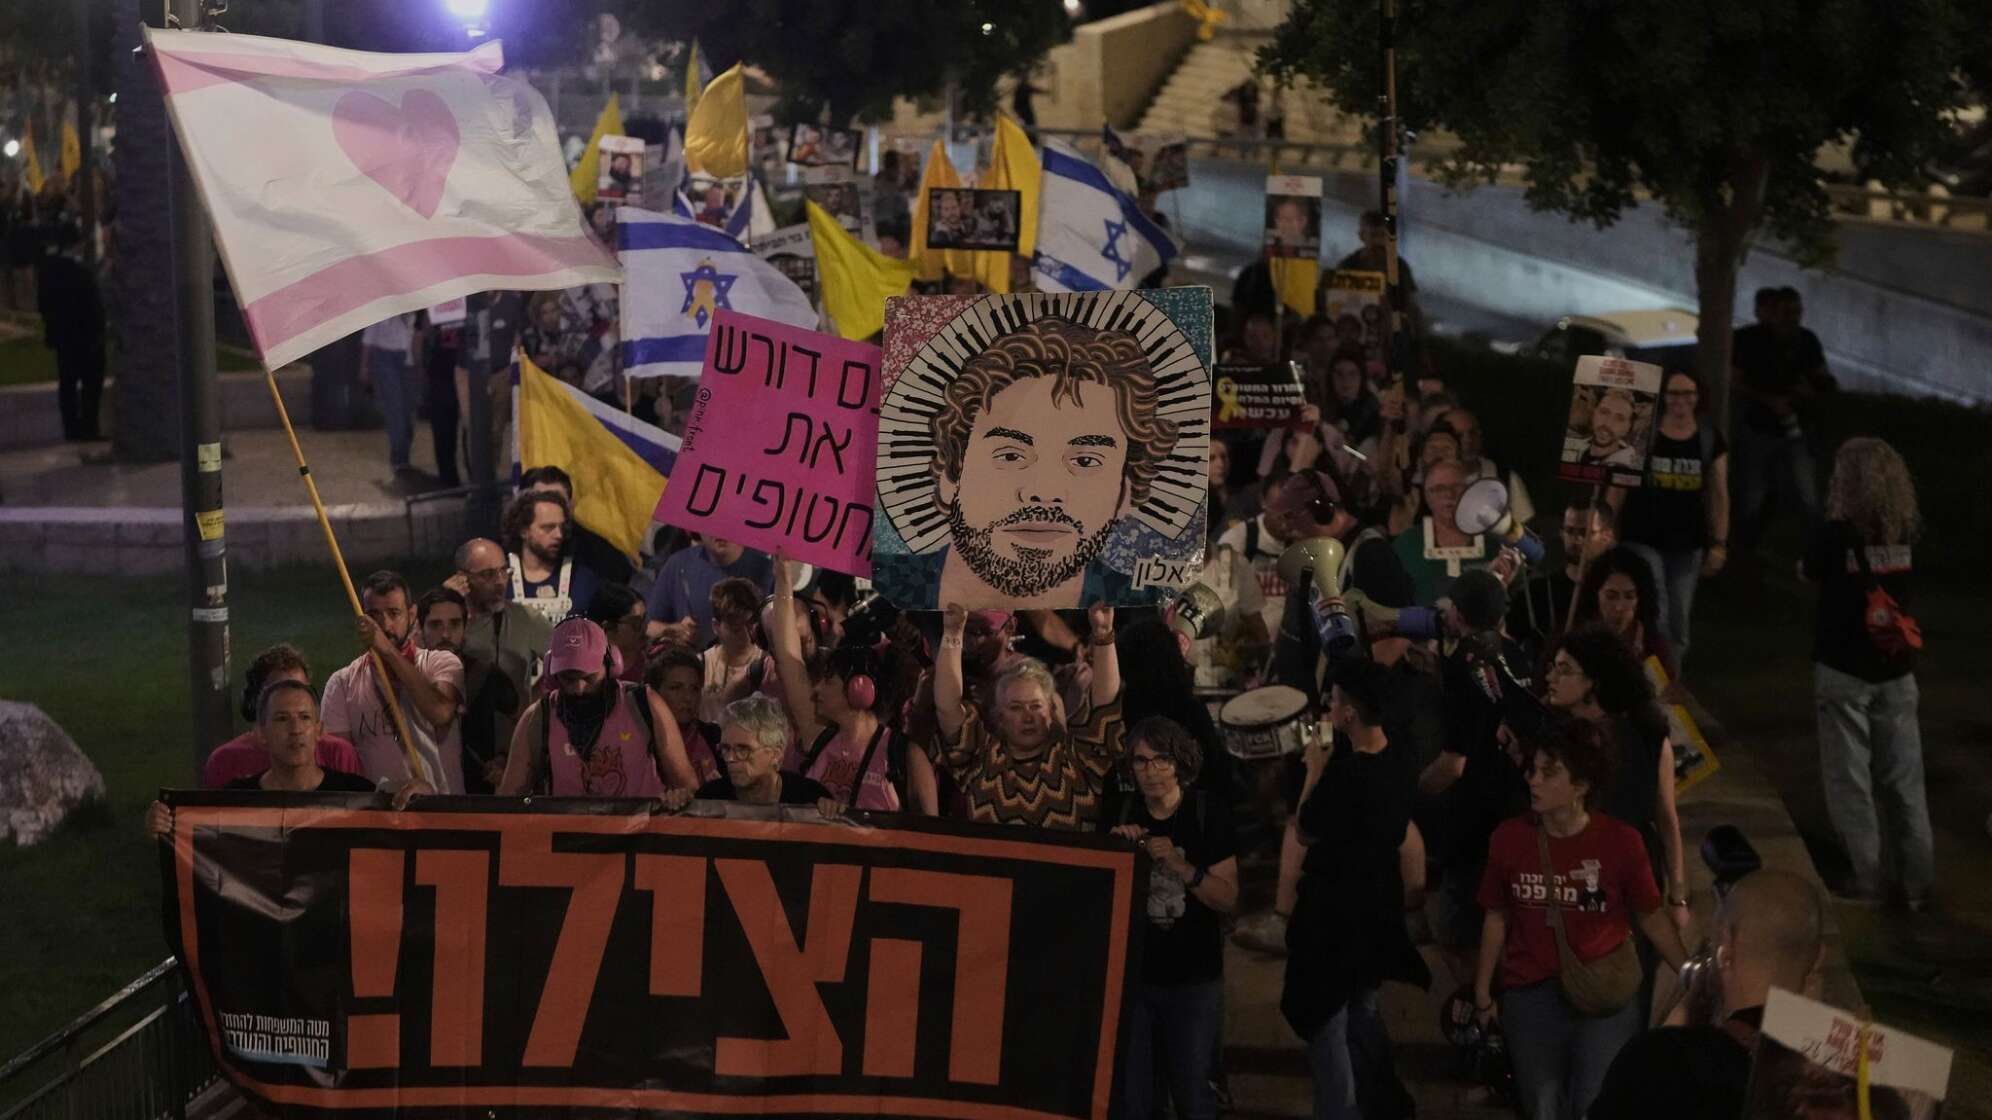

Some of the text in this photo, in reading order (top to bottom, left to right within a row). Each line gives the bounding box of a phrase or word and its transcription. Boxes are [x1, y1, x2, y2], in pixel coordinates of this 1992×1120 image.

[714, 325, 822, 398] דורש
[764, 412, 852, 474] את
[685, 463, 874, 562] חטופים
[1136, 558, 1185, 587] אלון
[347, 813, 1014, 1086] הצילו!
[255, 1014, 305, 1035] המשפחות
[307, 1018, 330, 1037] מטה
[274, 1035, 330, 1061] החטופים
